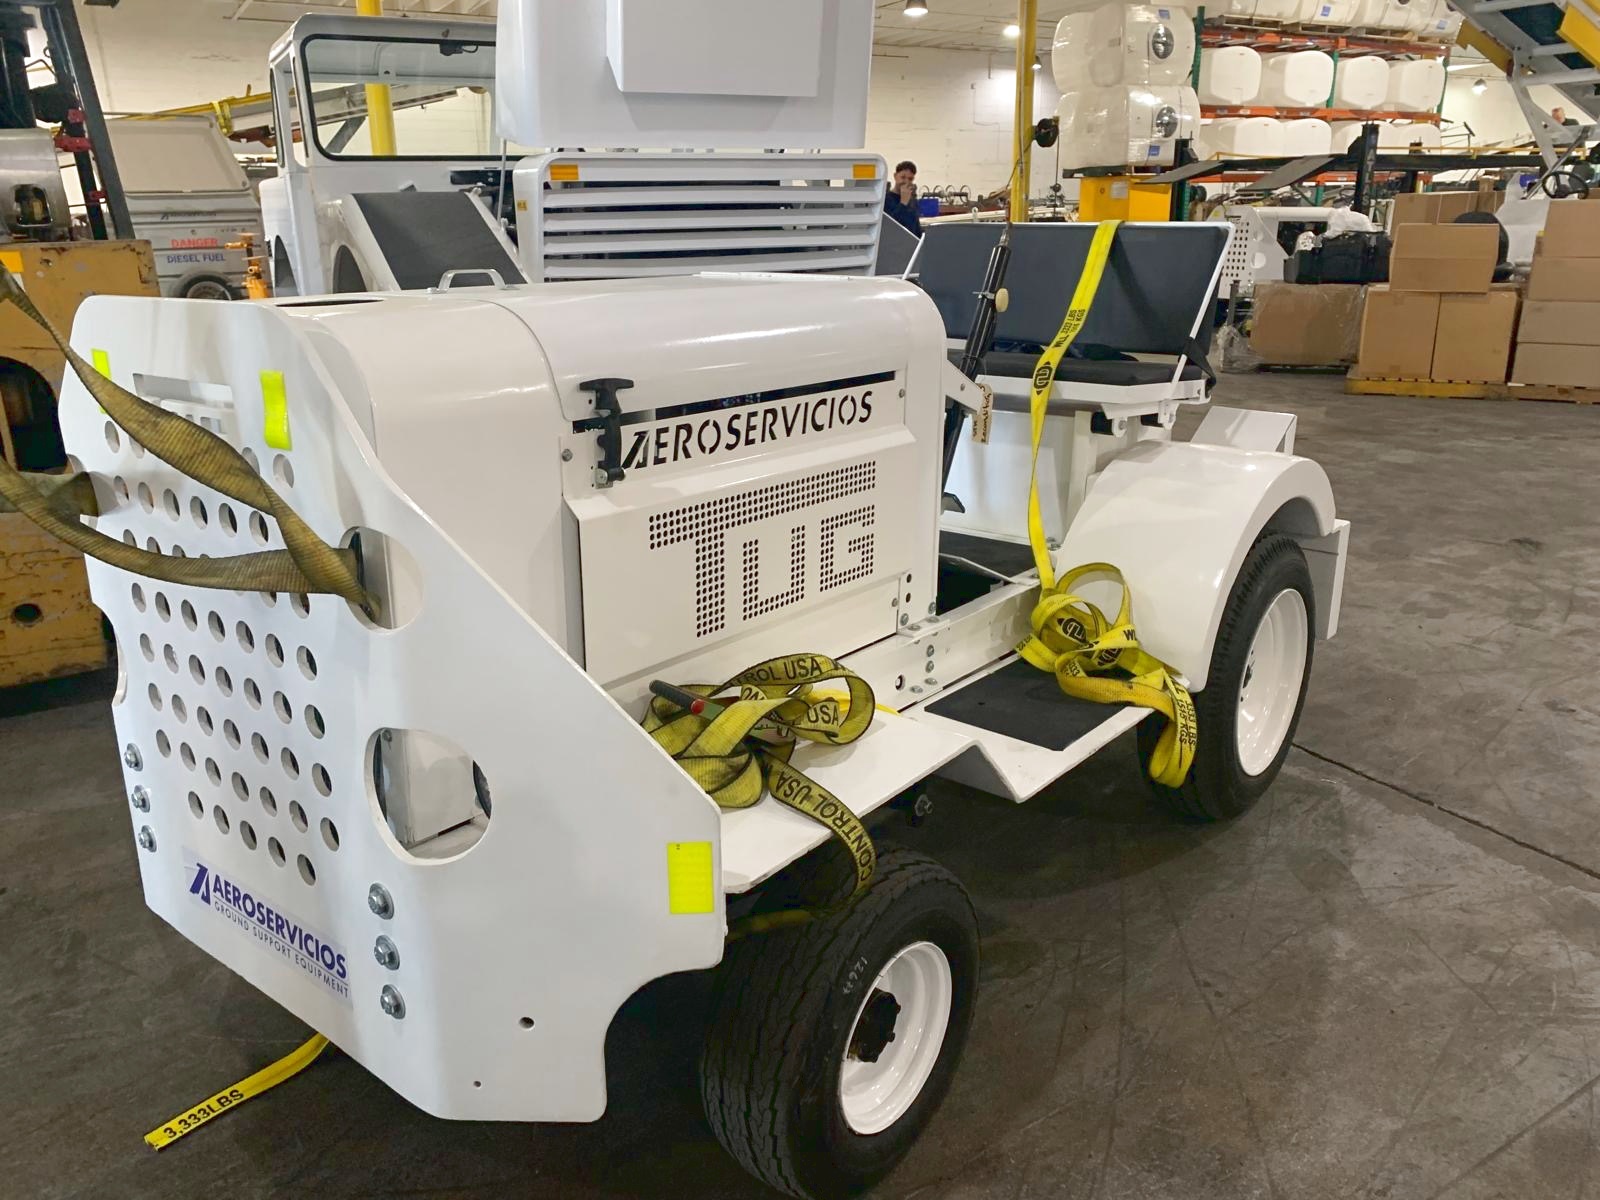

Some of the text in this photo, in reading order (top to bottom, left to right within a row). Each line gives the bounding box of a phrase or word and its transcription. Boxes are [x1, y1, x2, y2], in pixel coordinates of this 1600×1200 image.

[171, 238, 218, 250] DANGER
[167, 254, 226, 264] DIESEL FUEL
[1066, 309, 1077, 322] LBS
[1075, 309, 1086, 322] KGS
[622, 390, 873, 469] AEROSERVICIOS
[649, 460, 876, 637] TUG
[784, 656, 823, 680] USA
[806, 703, 840, 727] USA
[1179, 721, 1188, 744] KGS
[1188, 722, 1197, 746] LBS
[775, 771, 873, 881] CONTROL USA
[213, 873, 347, 980] AEROSERVICIOS
[214, 901, 349, 998] GROUND SUPPORT EQUIPMENT
[163, 1088, 245, 1138] 3,333LBS
